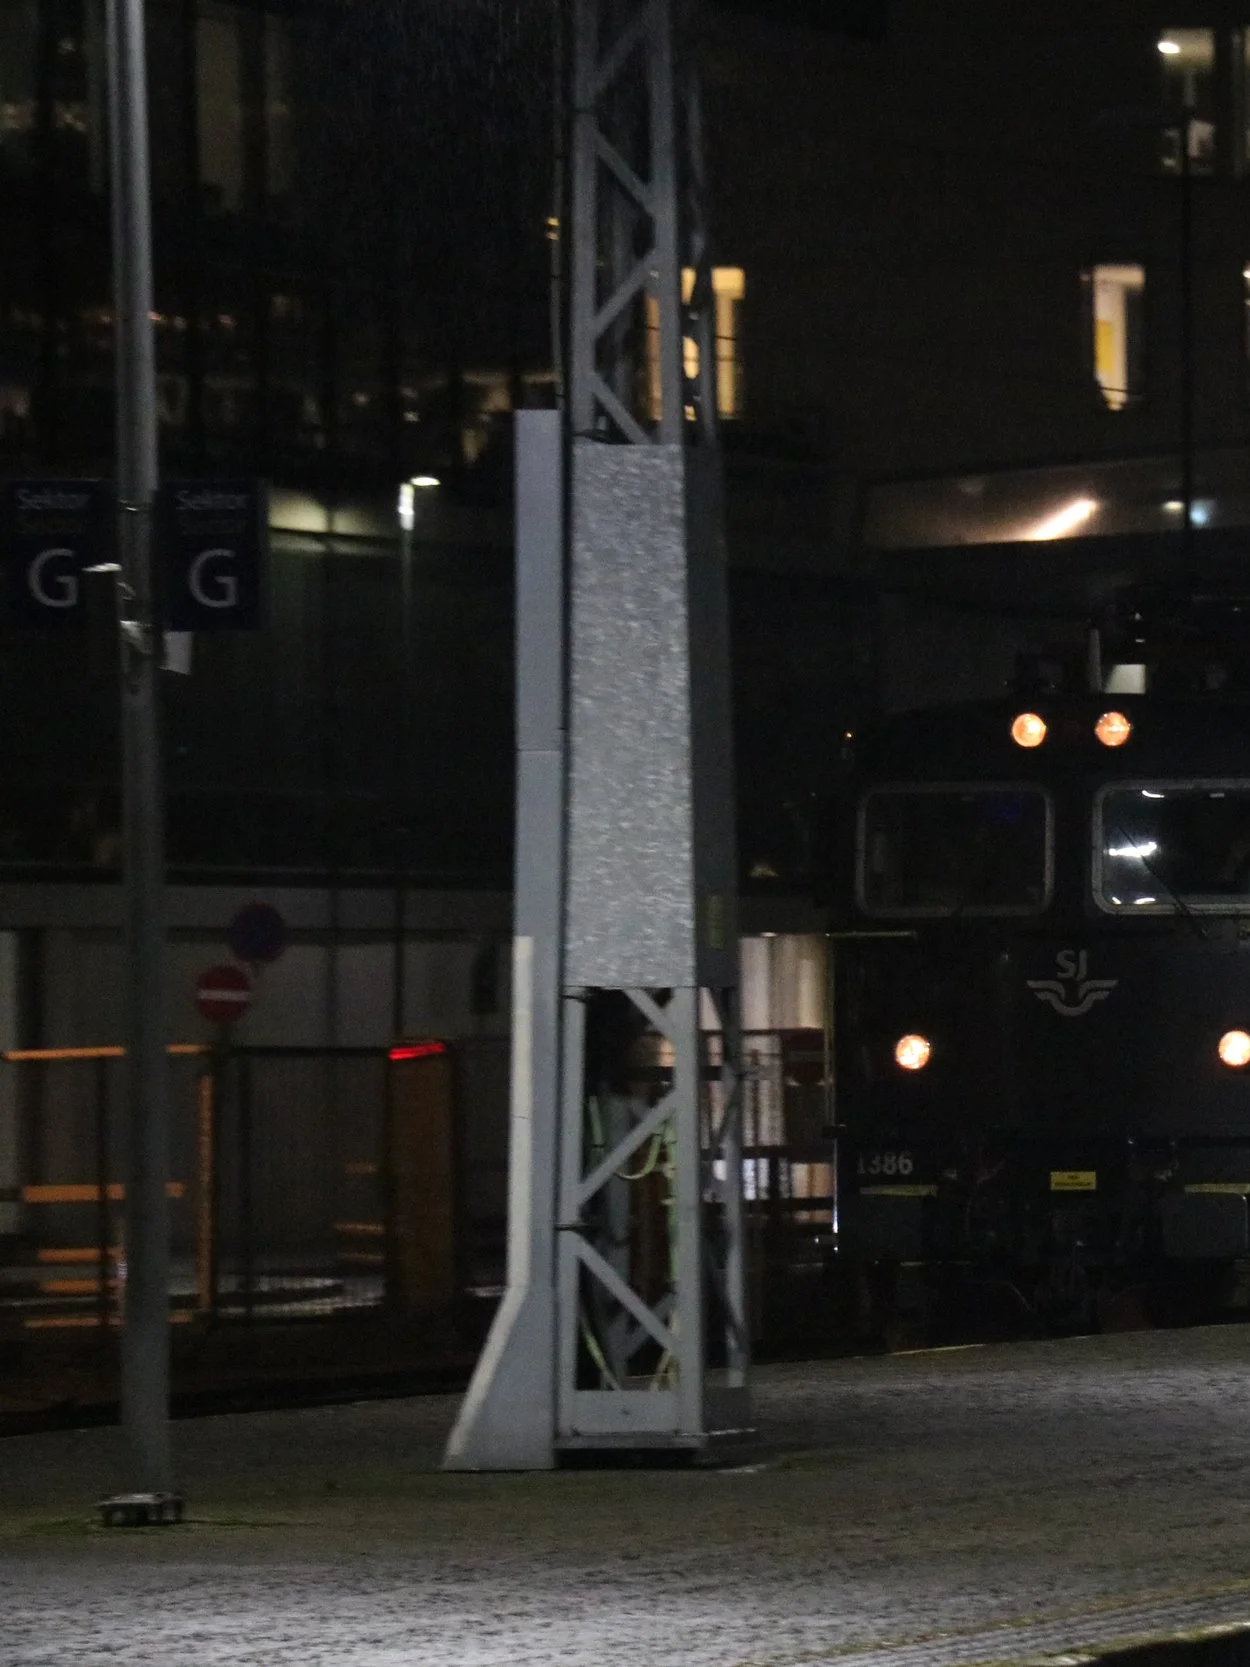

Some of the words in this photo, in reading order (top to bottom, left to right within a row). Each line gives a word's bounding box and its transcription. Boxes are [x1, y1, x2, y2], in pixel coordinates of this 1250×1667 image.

[28, 548, 79, 608] G
[188, 548, 239, 608] G
[1056, 949, 1088, 981] SJ
